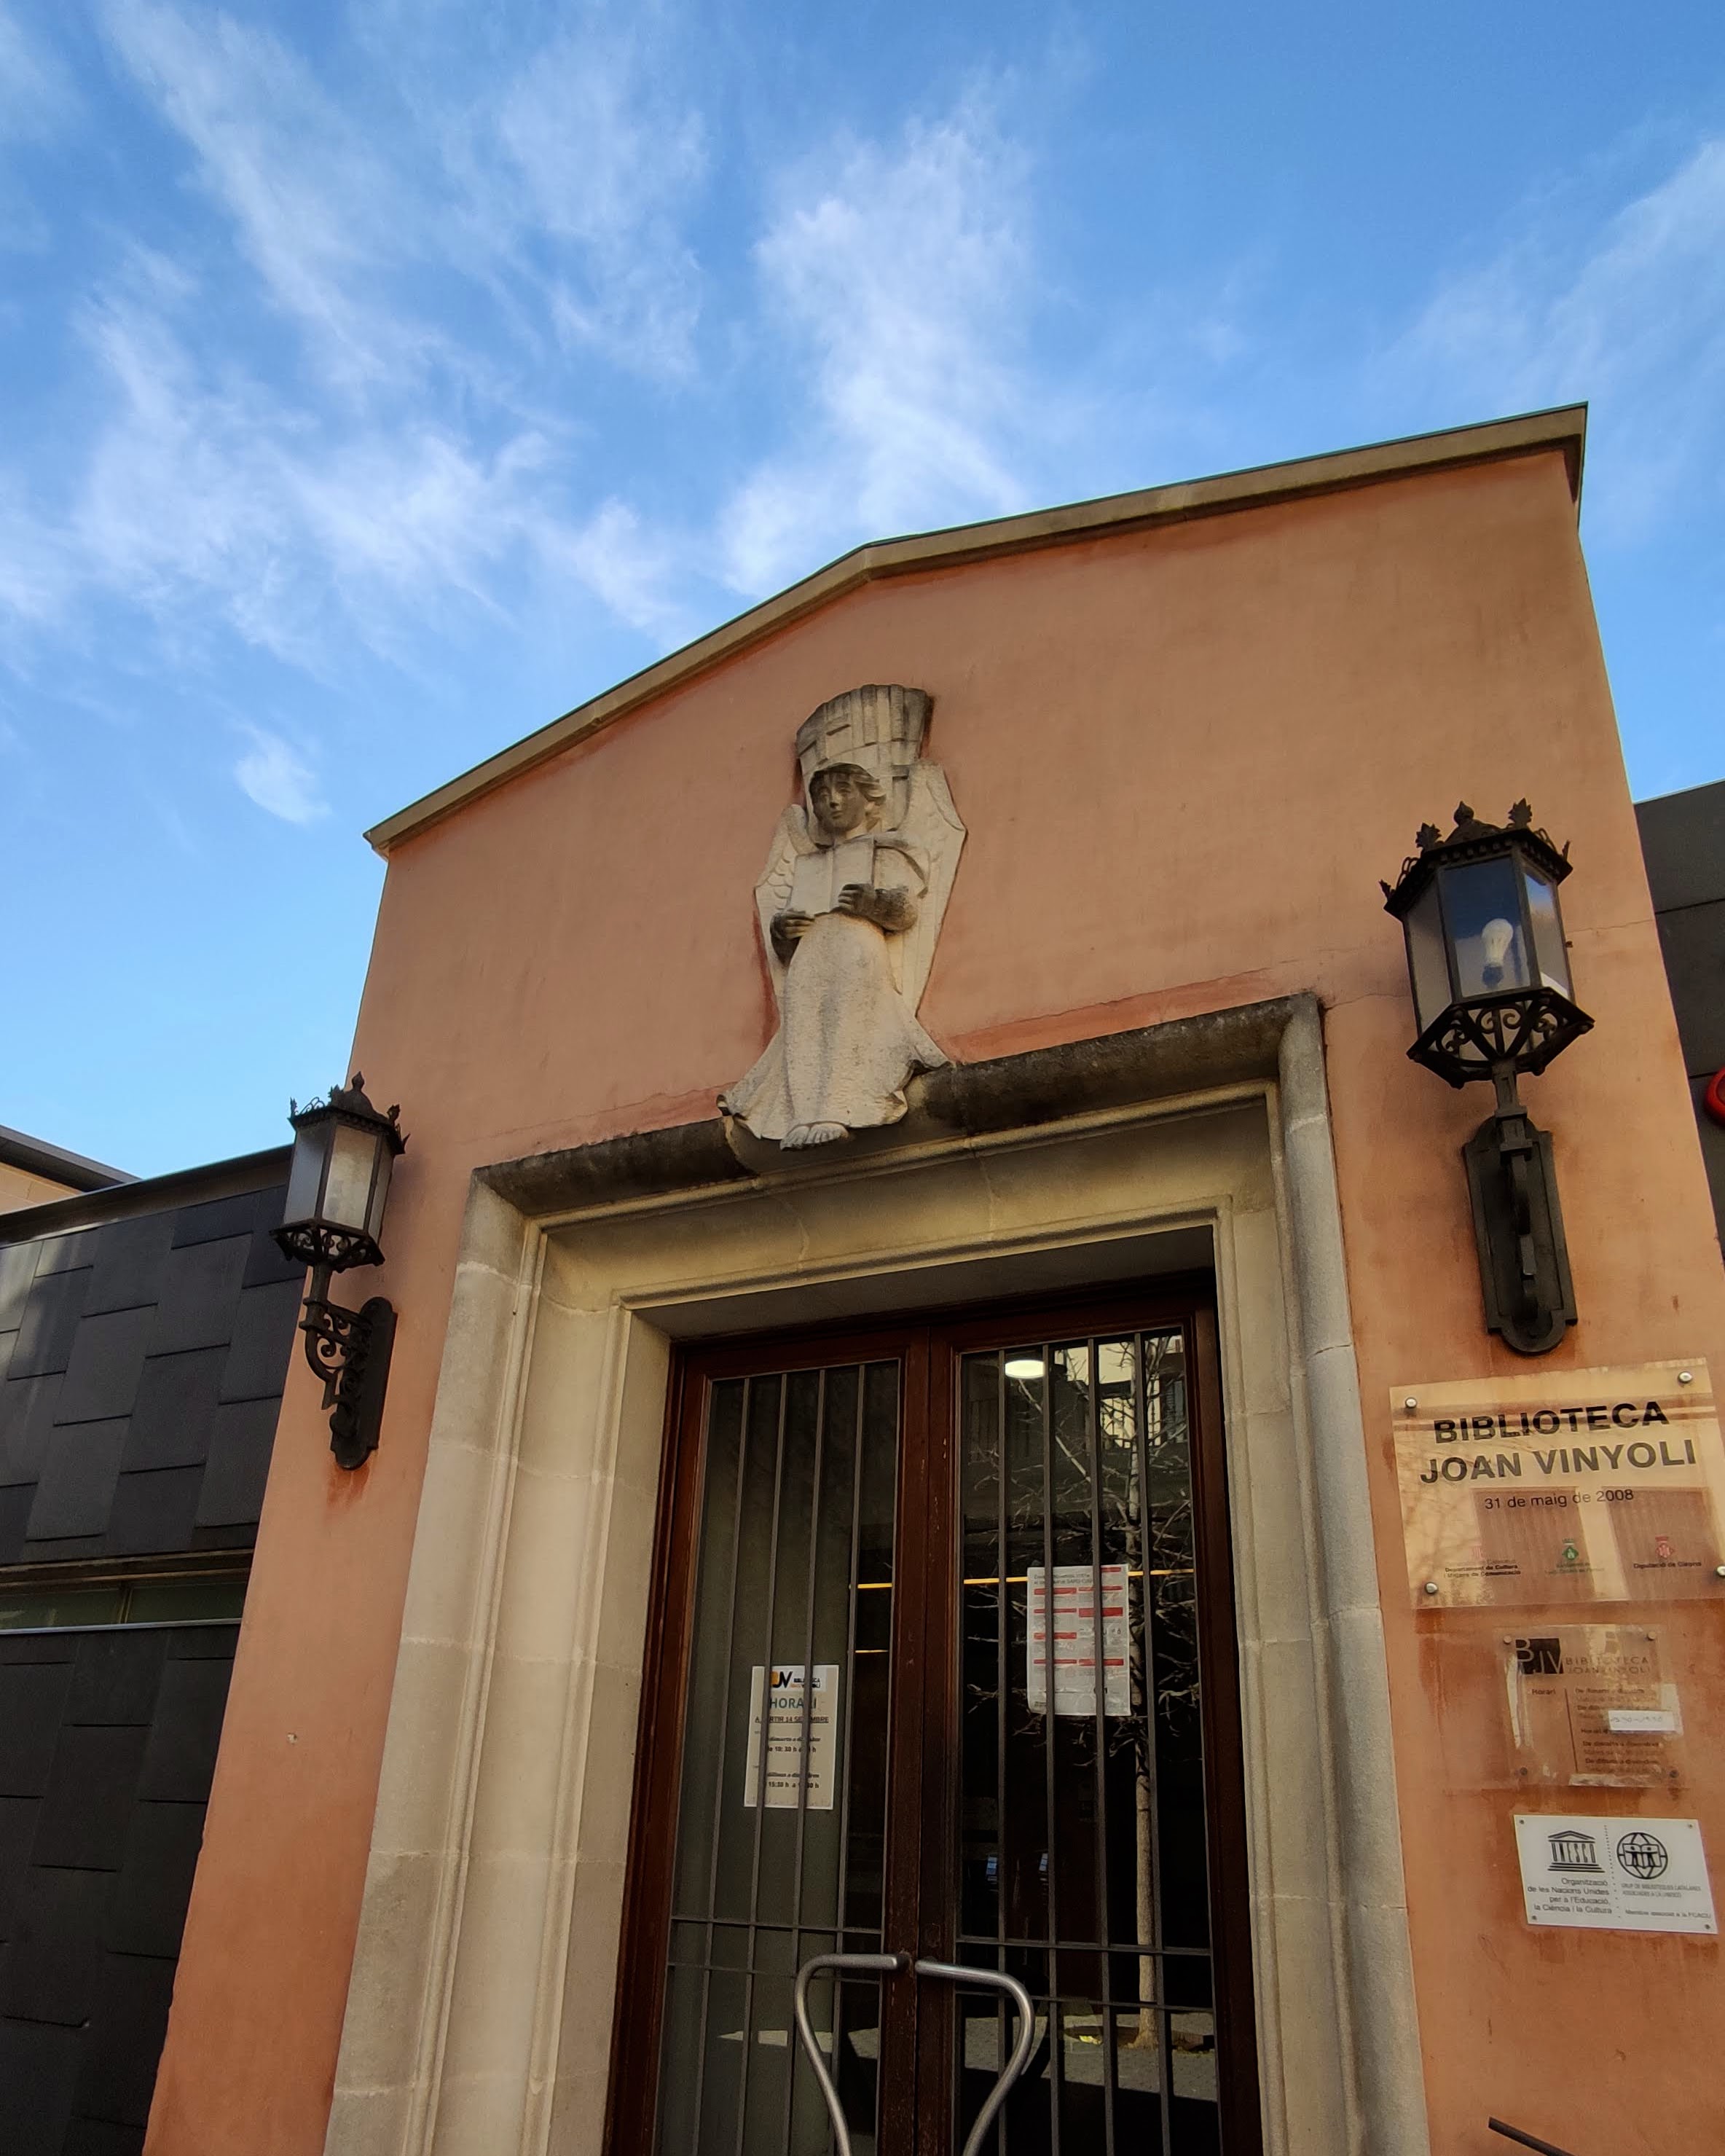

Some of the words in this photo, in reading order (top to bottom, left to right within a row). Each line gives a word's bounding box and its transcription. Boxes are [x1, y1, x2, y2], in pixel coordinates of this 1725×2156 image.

[1434, 1401, 1670, 1443] BIBLIOTECA
[1421, 1452, 1522, 1483] JOAN
[1532, 1439, 1696, 1475] VINYOLI
[1485, 1497, 1501, 1510] 31
[1507, 1495, 1526, 1509] de
[1531, 1494, 1568, 1509] maig
[1573, 1490, 1591, 1504] de
[1596, 1488, 1634, 1502] 2008
[769, 1698, 817, 1709] HORAI
[1561, 1878, 1608, 1886] Organització
